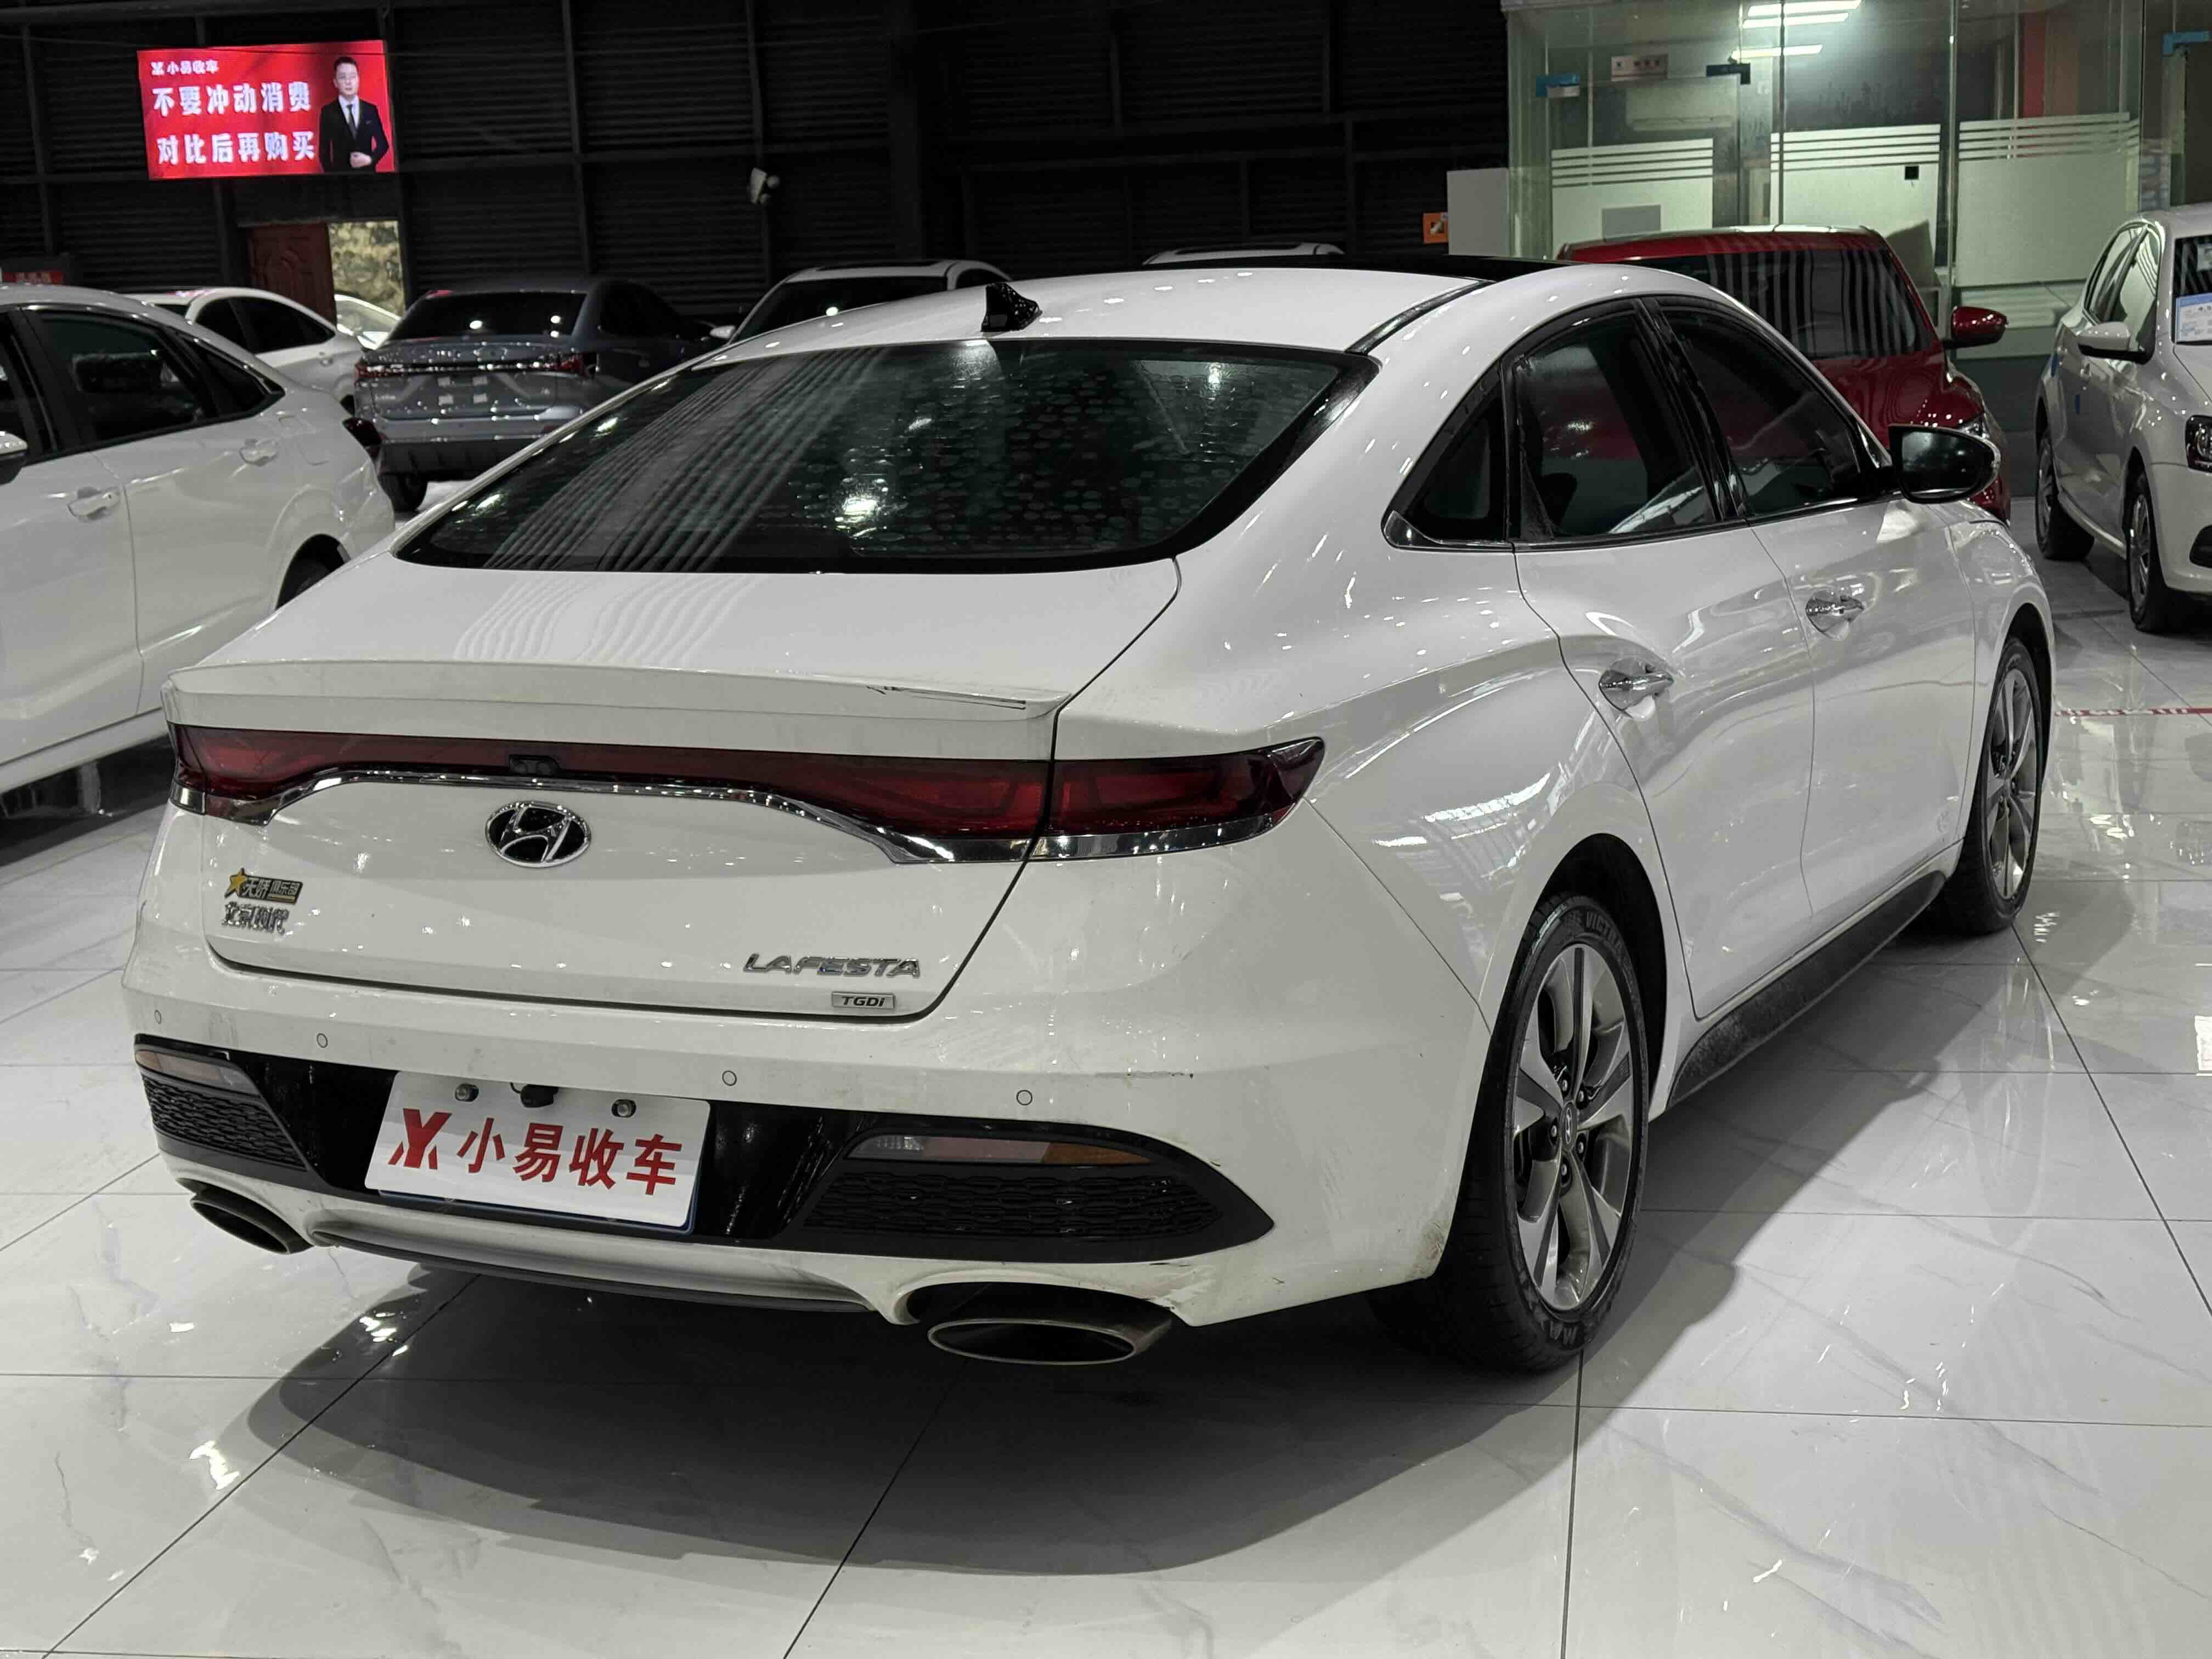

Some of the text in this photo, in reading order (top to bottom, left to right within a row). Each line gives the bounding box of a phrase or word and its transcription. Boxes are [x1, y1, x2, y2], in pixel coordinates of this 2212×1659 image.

[167, 59, 218, 75] 小易收车
[152, 81, 311, 117] 不要冲动消费
[157, 131, 315, 165] 对比后再购买
[743, 953, 921, 979] LAFESTA
[456, 1117, 682, 1195] 小易收车
